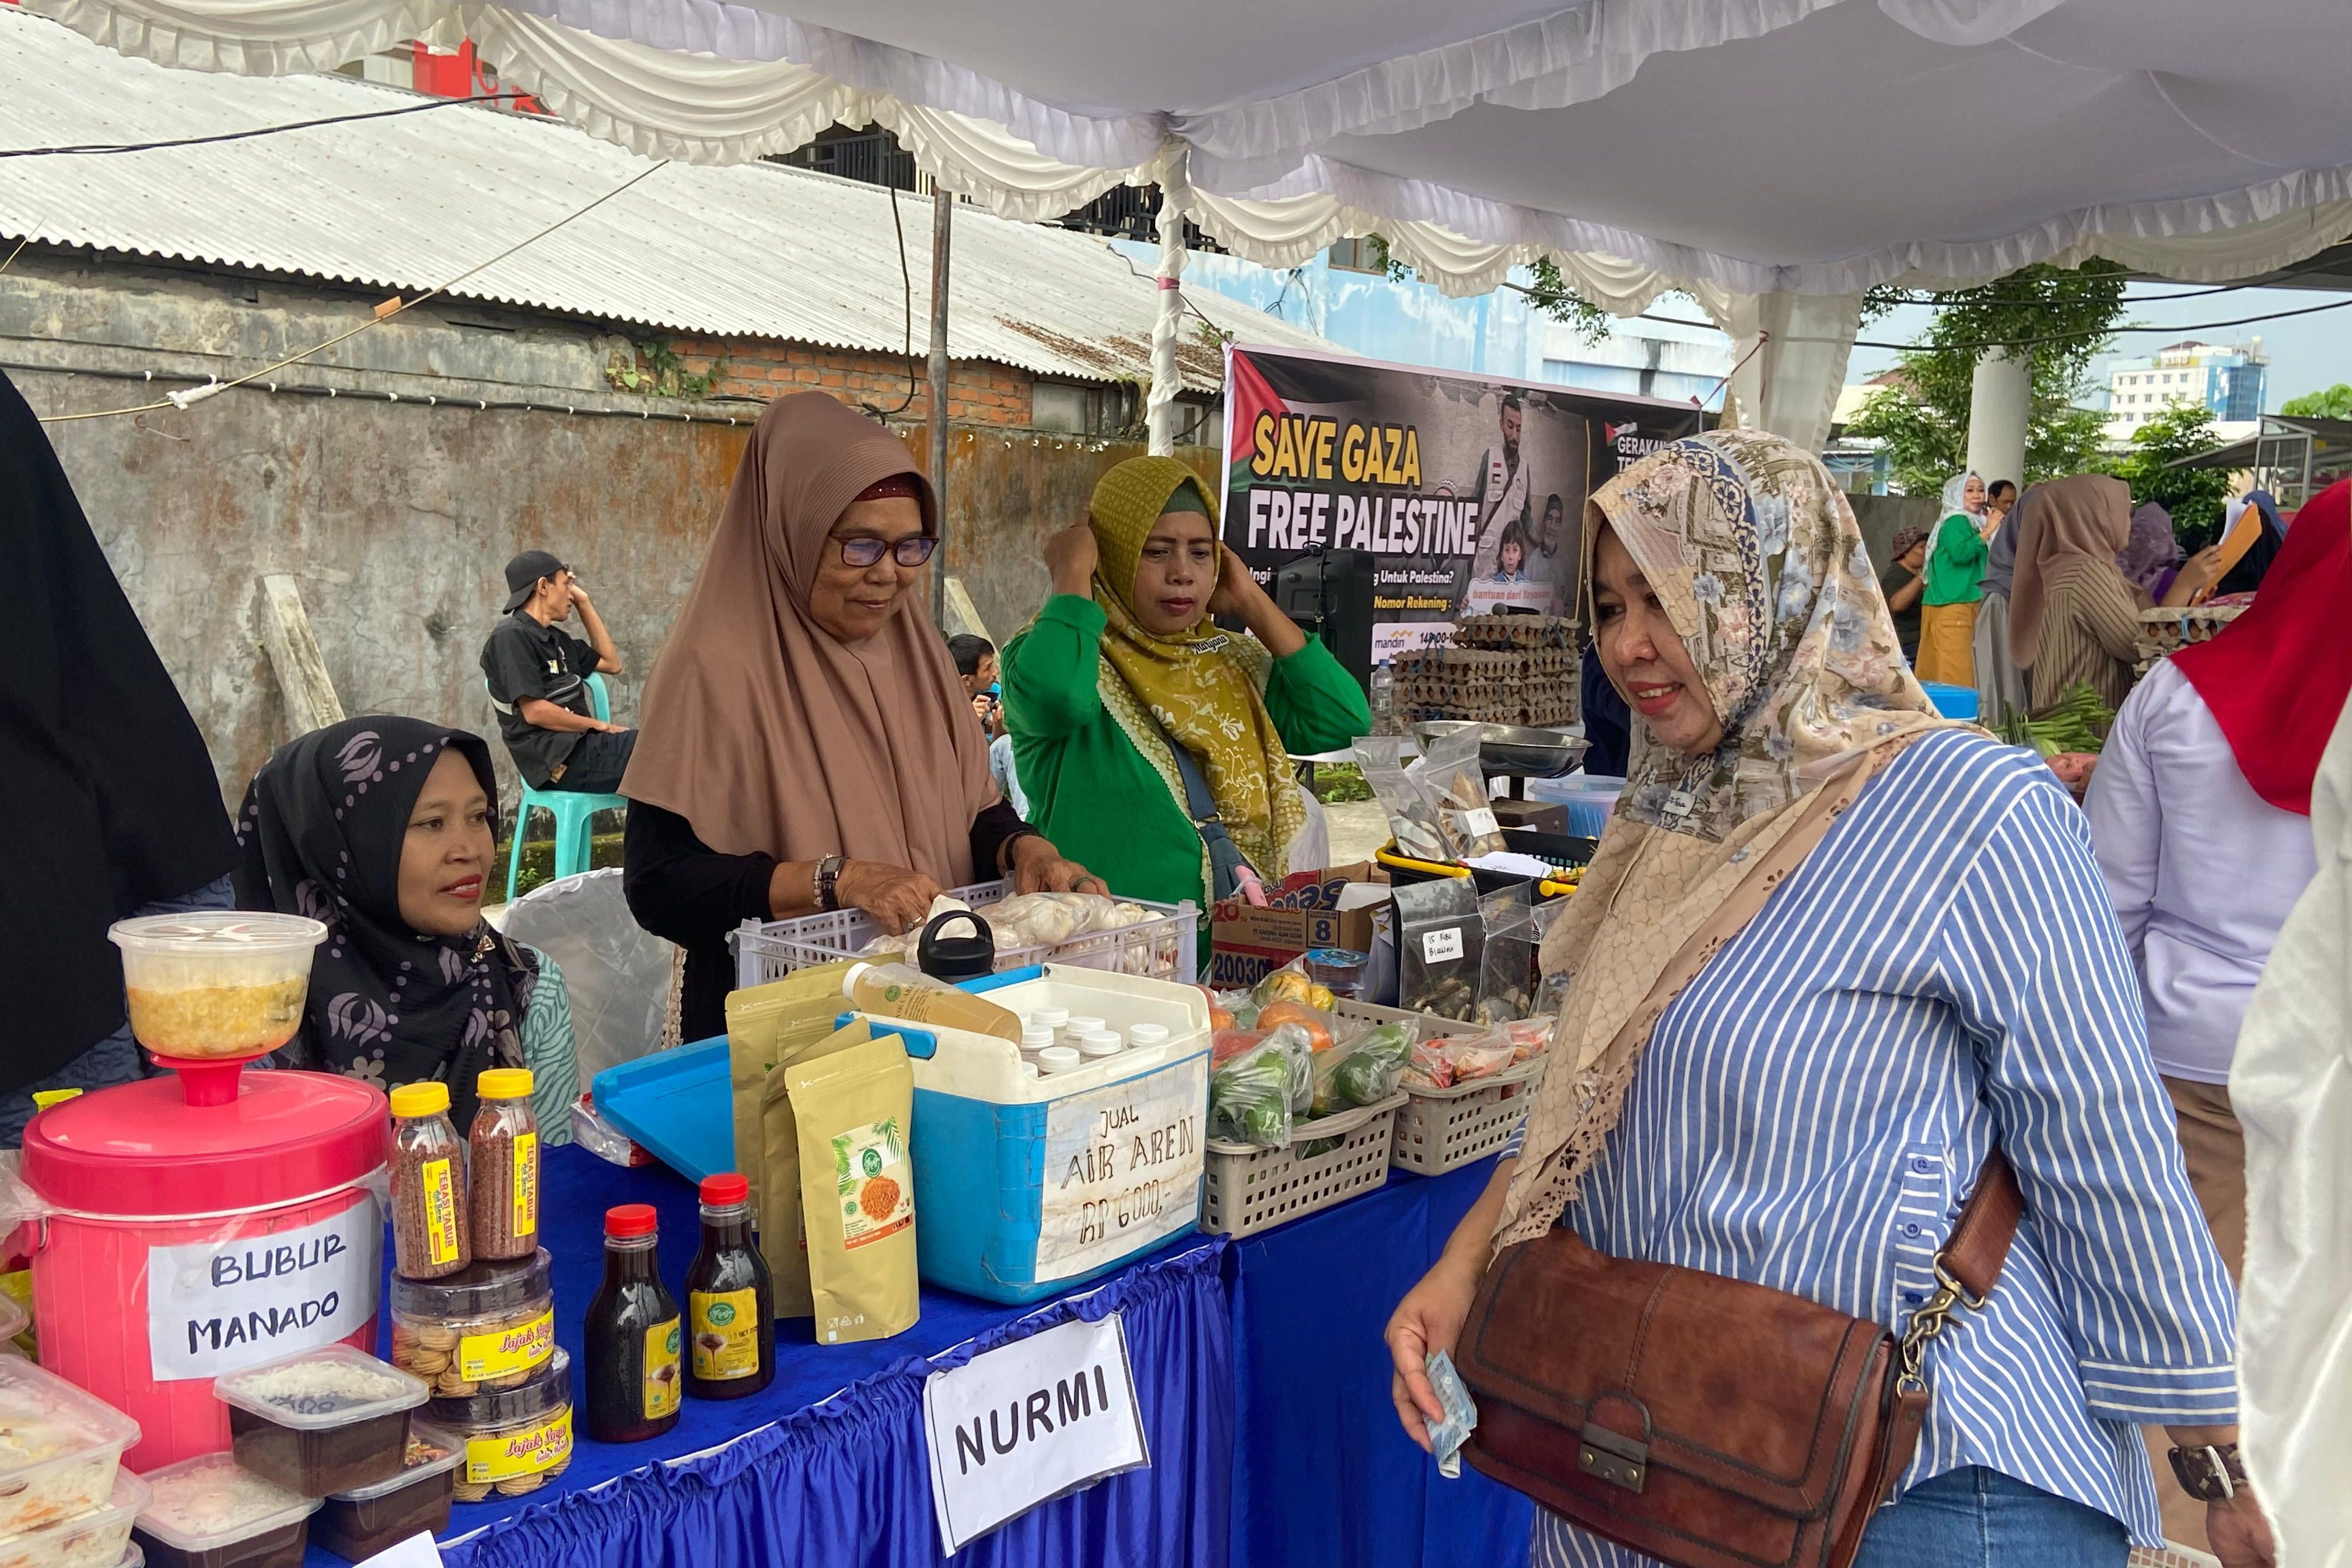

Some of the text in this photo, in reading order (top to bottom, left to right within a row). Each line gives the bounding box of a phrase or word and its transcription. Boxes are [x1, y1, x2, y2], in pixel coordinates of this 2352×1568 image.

[1251, 414, 1422, 487] SAVE GAZA
[1248, 489, 1479, 555] FREE PALESTINE
[1381, 570, 1407, 583] Untuk
[1409, 570, 1454, 584] Palestina?
[1473, 589, 1504, 600] bantuan
[1507, 590, 1521, 600] dari
[1374, 596, 1405, 609] Nomor
[1407, 596, 1447, 611] Rekening
[1315, 920, 1331, 941] 8
[1100, 1104, 1139, 1138] JUAL
[1130, 1115, 1194, 1171] AREN
[439, 1169, 454, 1248] TERASI TABUR
[211, 1234, 346, 1287] BUBUR
[187, 1291, 339, 1355] MANADO
[499, 1327, 534, 1353] Jajak
[505, 1423, 566, 1458] Jajak Sagu
[955, 1364, 1109, 1475] NURMI
